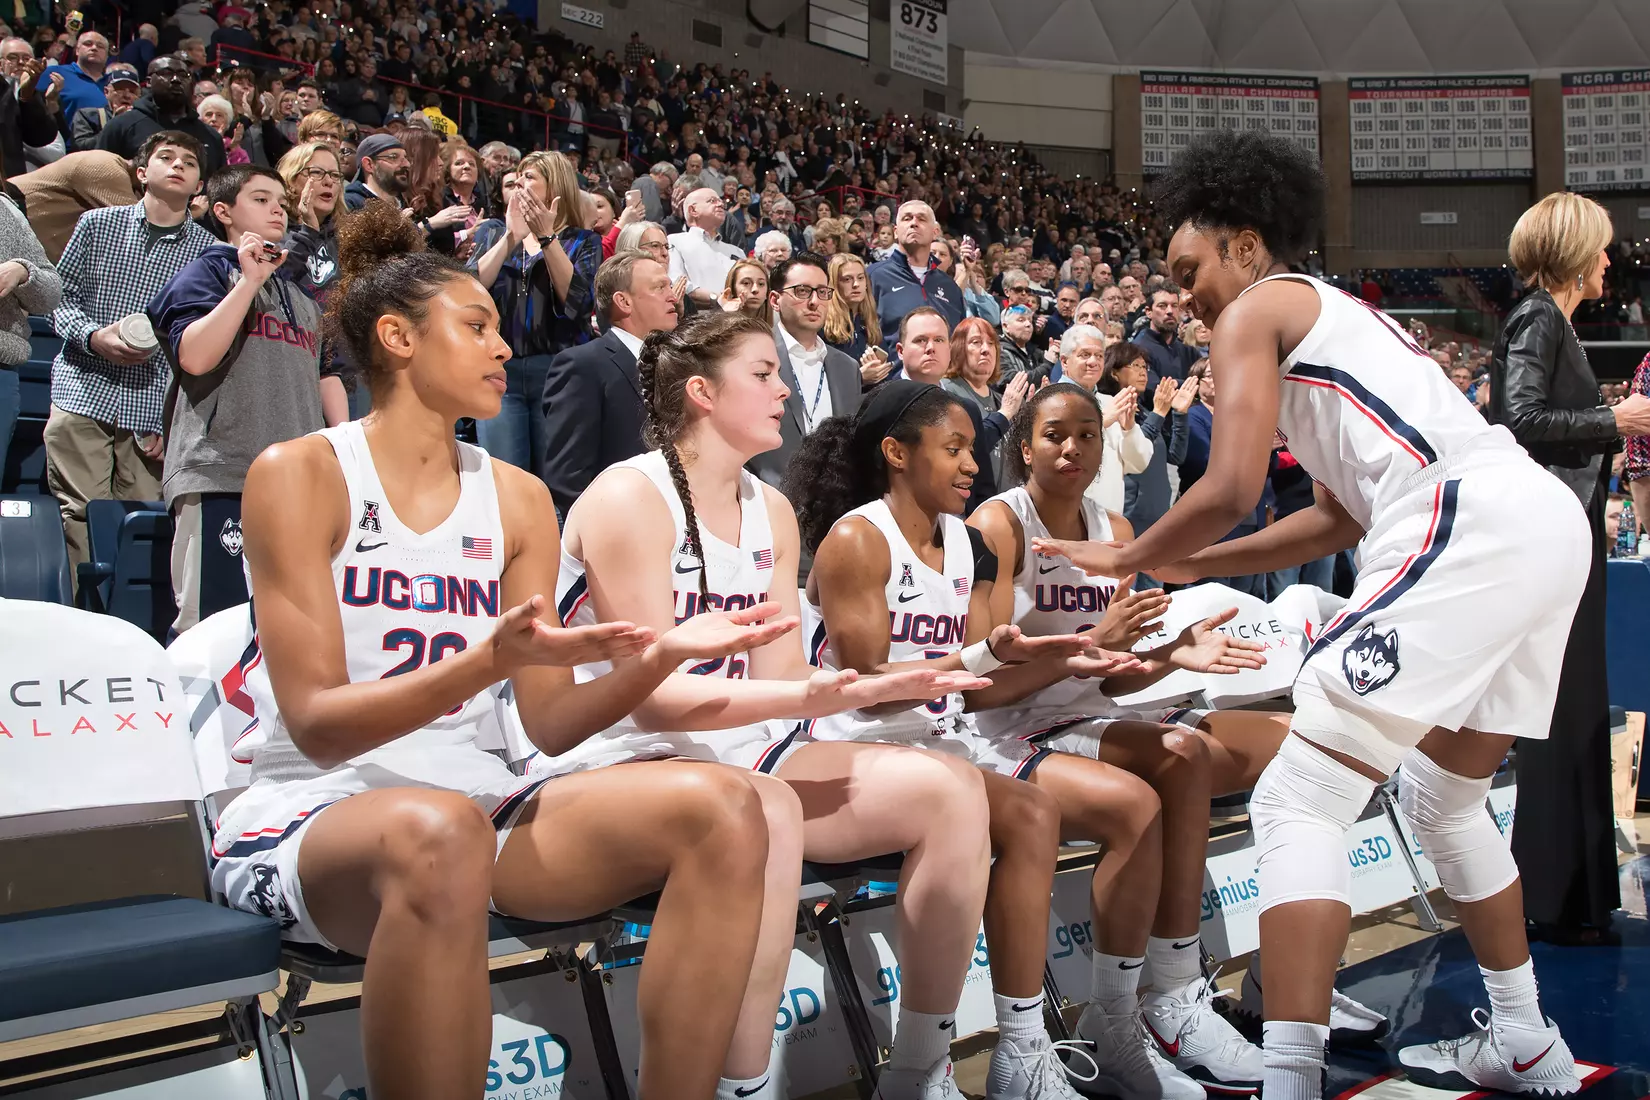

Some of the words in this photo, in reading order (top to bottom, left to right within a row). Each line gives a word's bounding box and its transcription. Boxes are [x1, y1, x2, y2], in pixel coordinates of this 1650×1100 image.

[563, 7, 577, 17] SEC
[580, 10, 602, 25] 222
[901, 3, 938, 33] 873
[1143, 74, 1156, 82] BIG
[1159, 74, 1177, 82] EAST
[1188, 75, 1228, 84] AMERICAN
[1229, 77, 1264, 85] ATHLETIC
[1267, 78, 1314, 87] CONFERENCE
[1367, 80, 1386, 88] EAST
[1572, 73, 1614, 84] NCAA
[1144, 86, 1195, 94] REGULAR
[1201, 87, 1245, 95] SEASON
[1250, 89, 1315, 98] CHAMPIONS
[1367, 90, 1441, 98] TOURNAMENT
[1448, 89, 1513, 97] CHAMPIONS
[1144, 96, 1163, 108] 1989
[1170, 97, 1189, 109] 1990
[1196, 98, 1214, 110] 1991
[1221, 99, 1240, 110] 1994
[1247, 100, 1265, 111] 1995
[1272, 101, 1290, 112] 1996
[1297, 102, 1315, 113] 1997
[1353, 102, 1372, 113] 1989
[1379, 102, 1397, 113] 1991
[1405, 102, 1423, 113] 1994
[1431, 101, 1449, 112] 1995
[1482, 100, 1500, 111] 1997
[1195, 116, 1215, 128] 2000
[1221, 117, 1240, 129] 2001
[1297, 120, 1316, 131] 2004
[1354, 120, 1372, 132] 1999
[1405, 119, 1424, 131] 2001
[1144, 133, 1164, 145] 2007
[1354, 138, 1373, 150] 2009
[1380, 138, 1399, 150] 2010
[1406, 137, 1425, 149] 2011
[1457, 136, 1477, 148] 2014
[1483, 136, 1502, 148] 2015
[1510, 136, 1528, 148] 2016
[1145, 151, 1163, 163] 2016
[1355, 156, 1373, 168] 2017
[1353, 172, 1419, 180] CONNECTICUT
[1471, 169, 1532, 178] BASKETBALL
[12, 502, 20, 515] 3
[342, 566, 499, 617] UCONN
[10, 677, 166, 707] CKET
[1348, 836, 1391, 868] us3D
[1201, 868, 1259, 922] genius
[784, 1027, 819, 1045] EXAM
